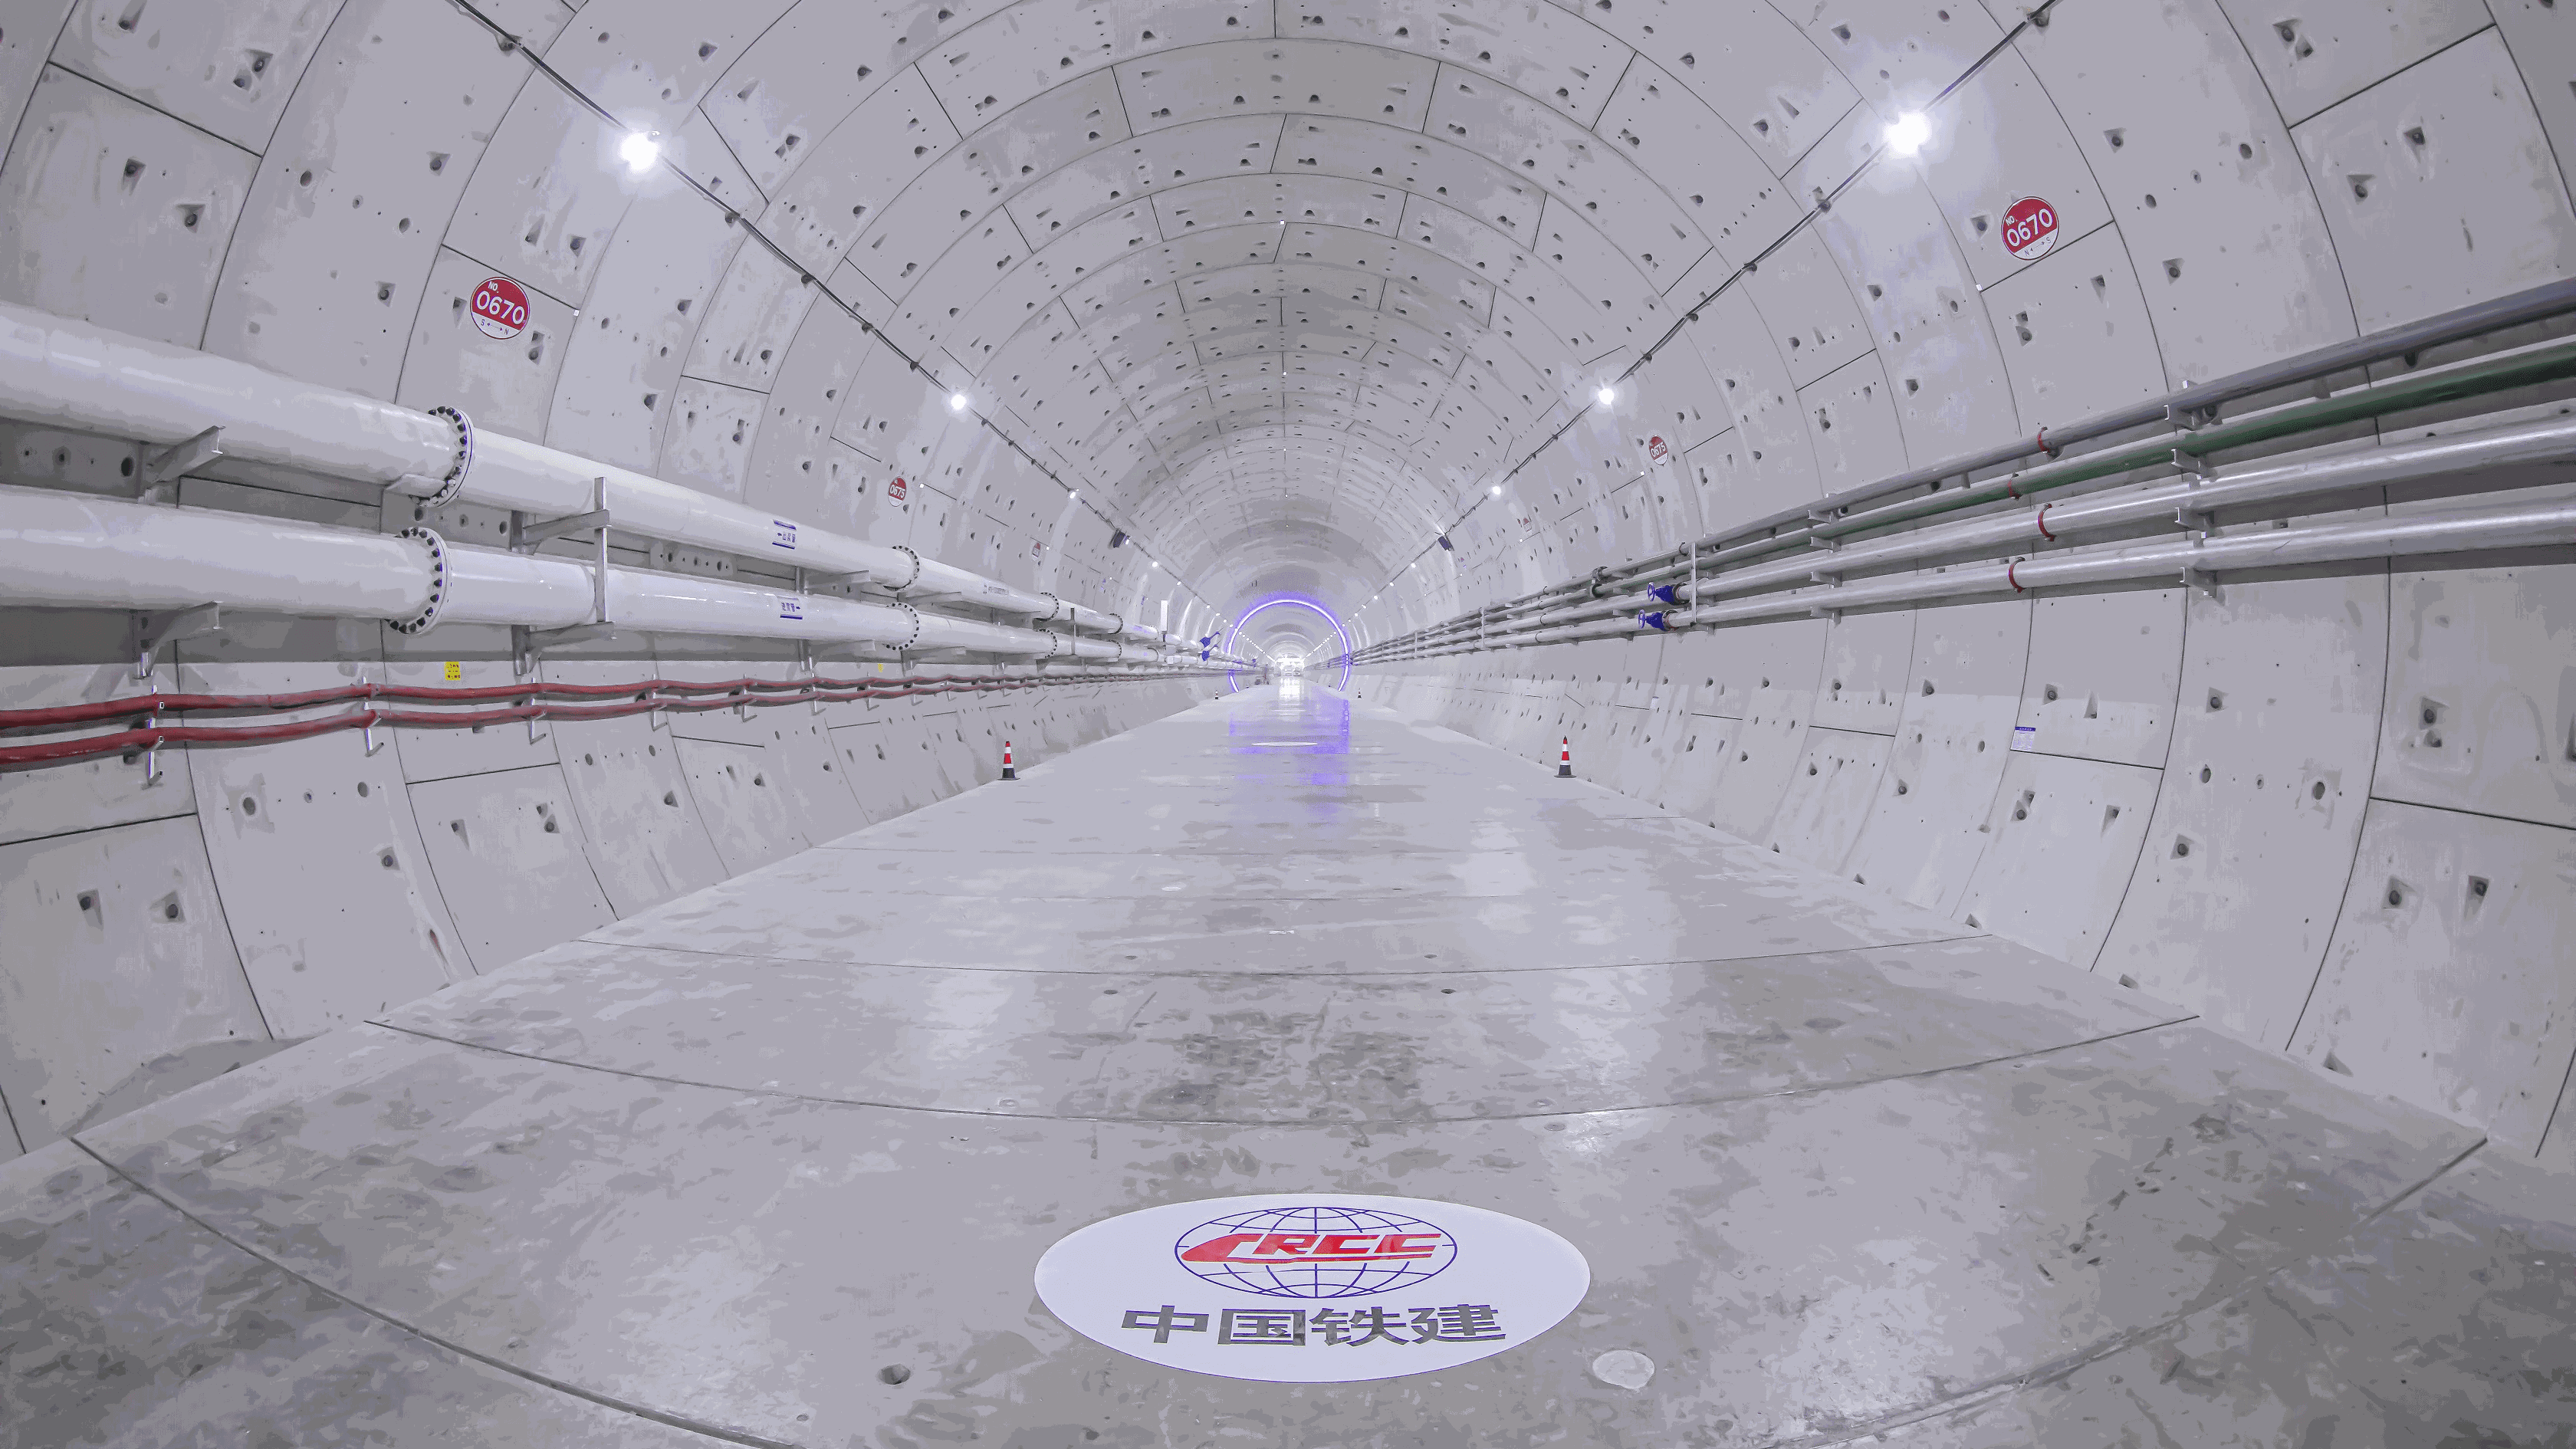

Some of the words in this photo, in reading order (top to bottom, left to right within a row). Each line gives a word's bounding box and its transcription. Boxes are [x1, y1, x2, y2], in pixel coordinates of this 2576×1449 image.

[2006, 215, 2018, 226] NO.
[2006, 209, 2052, 247] 0670
[488, 281, 499, 294] NO.
[476, 291, 525, 325] 0670
[1651, 442, 1666, 458] 0675
[890, 484, 906, 499] 0675
[1181, 1233, 1442, 1265] CRCC
[1120, 1303, 1507, 1347] 中国铁建
